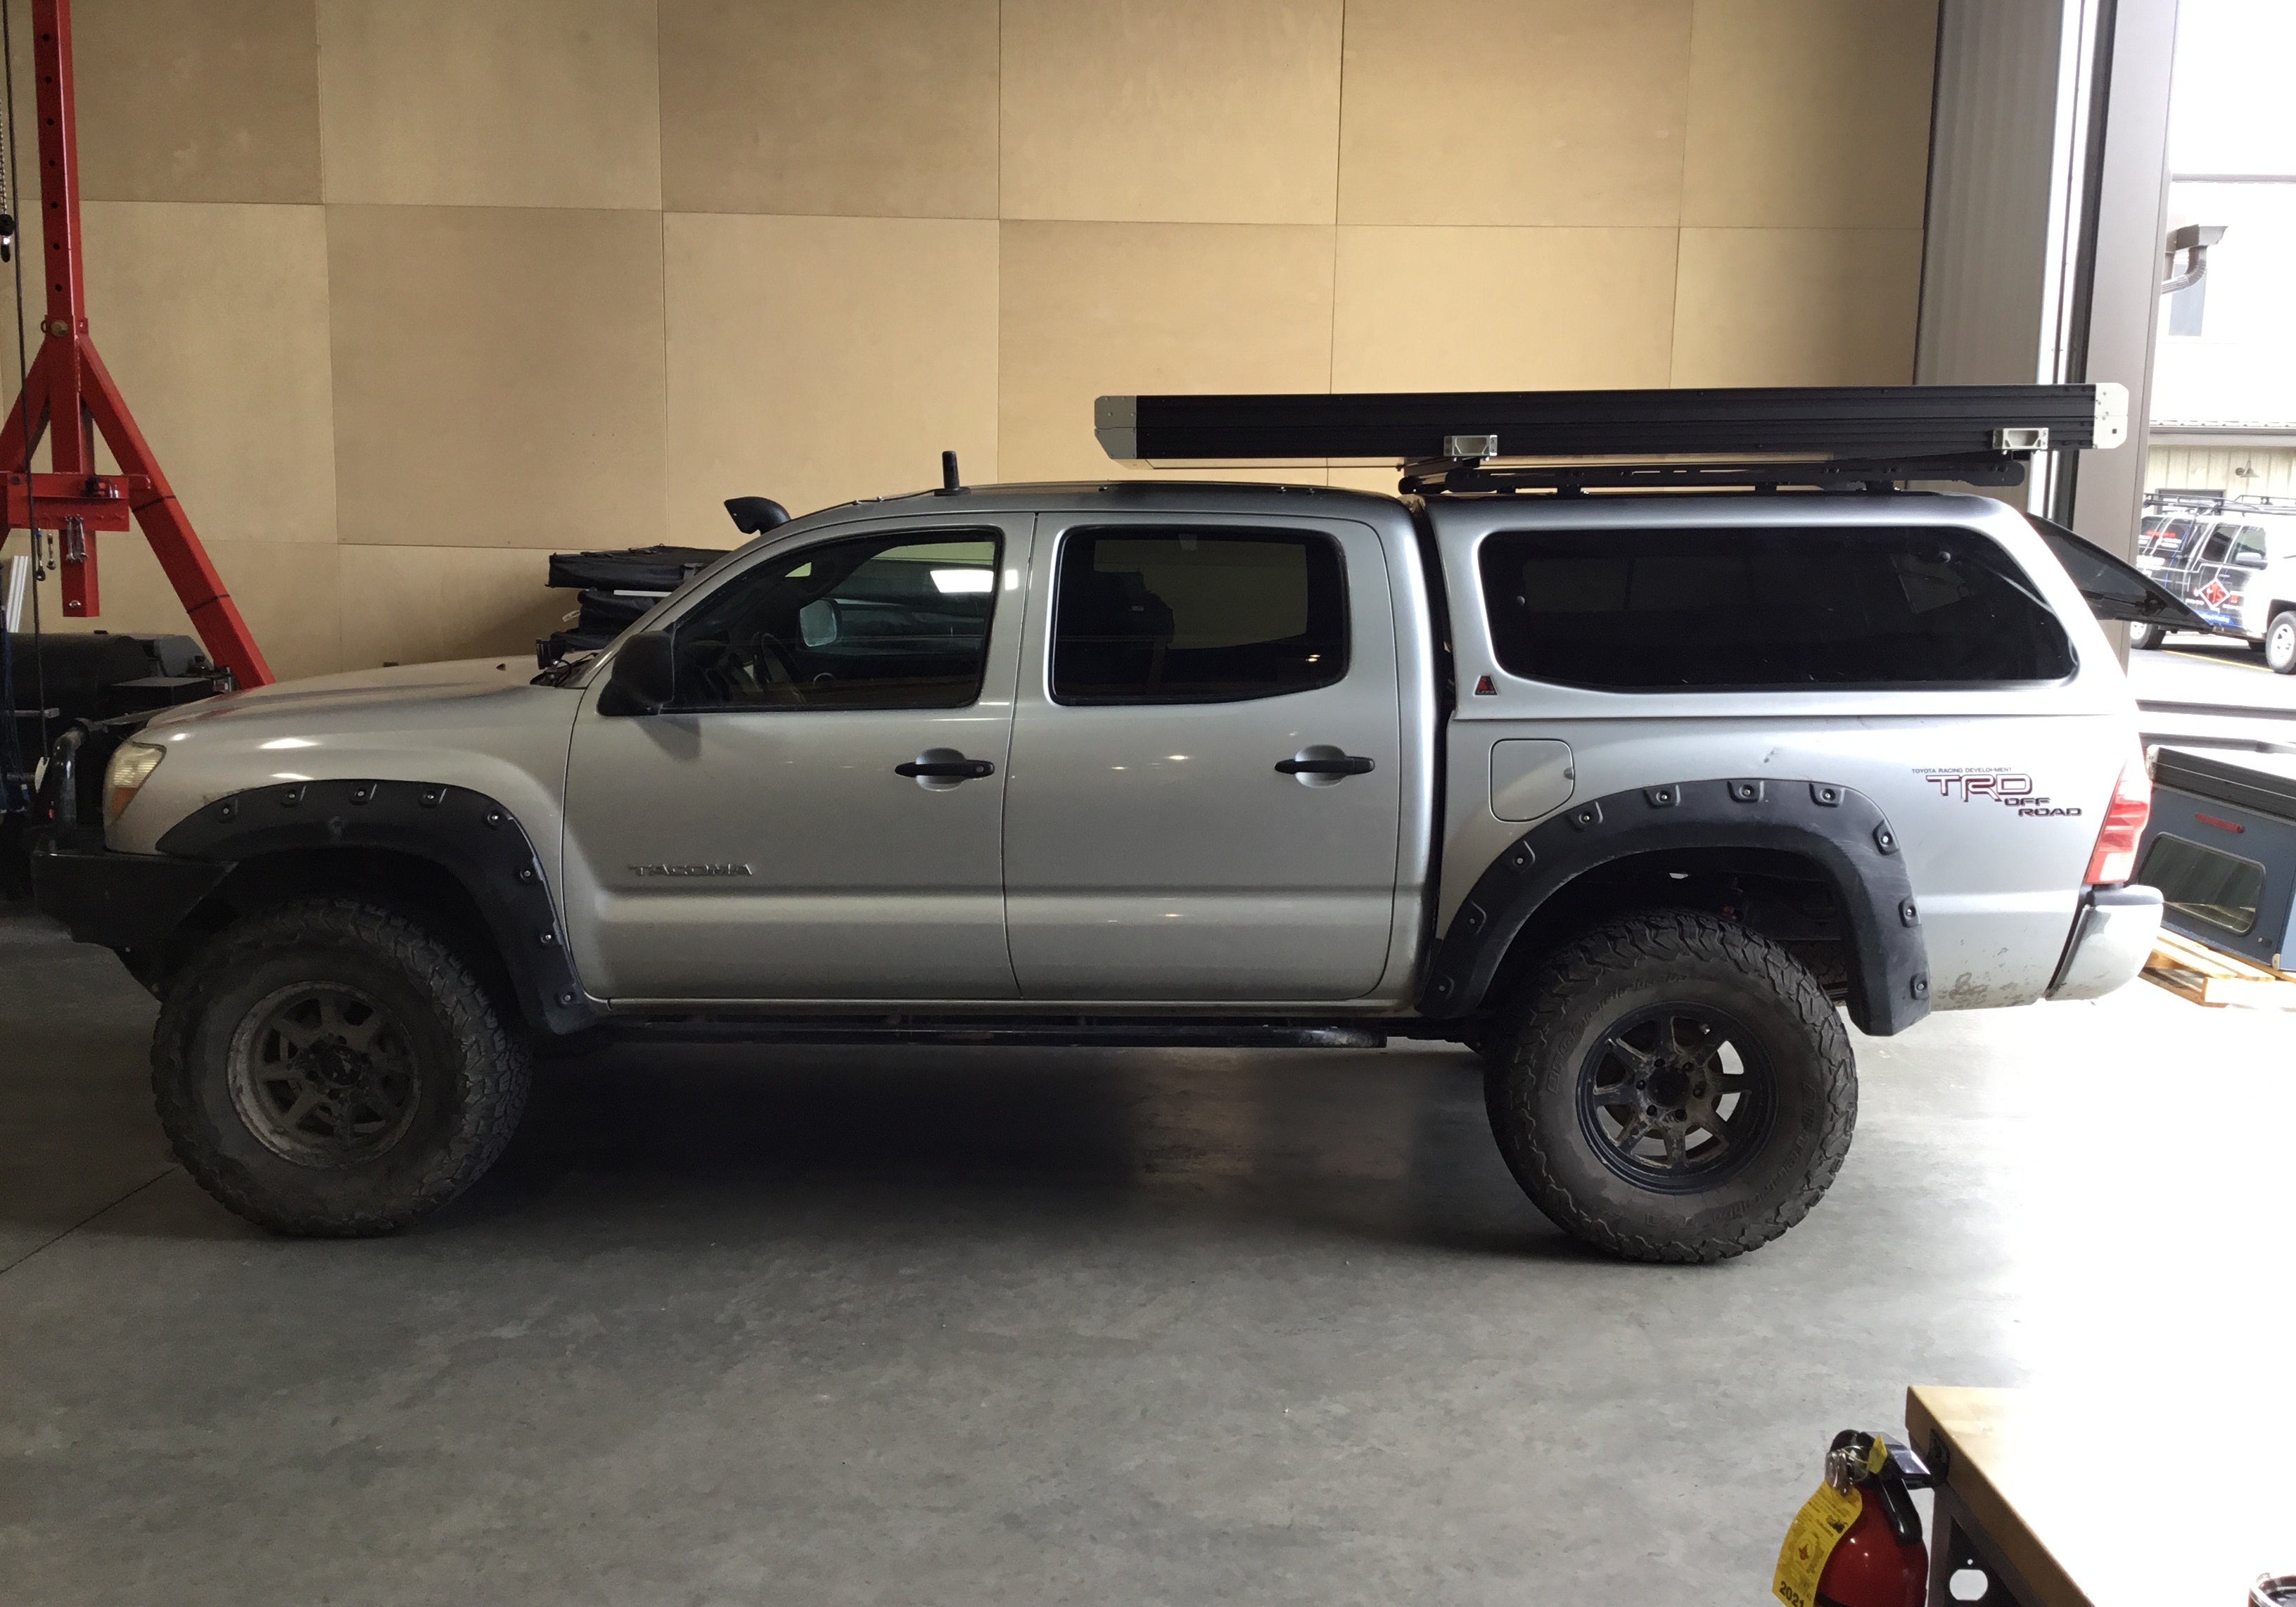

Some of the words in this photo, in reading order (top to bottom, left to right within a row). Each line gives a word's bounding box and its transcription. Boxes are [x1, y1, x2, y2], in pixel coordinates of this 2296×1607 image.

[1925, 773, 2032, 803] TRD
[2003, 797, 2051, 806] OFF
[2017, 808, 2082, 817] ROAD
[628, 863, 753, 877] TACOMA
[1778, 1580, 1805, 1607] 2021
